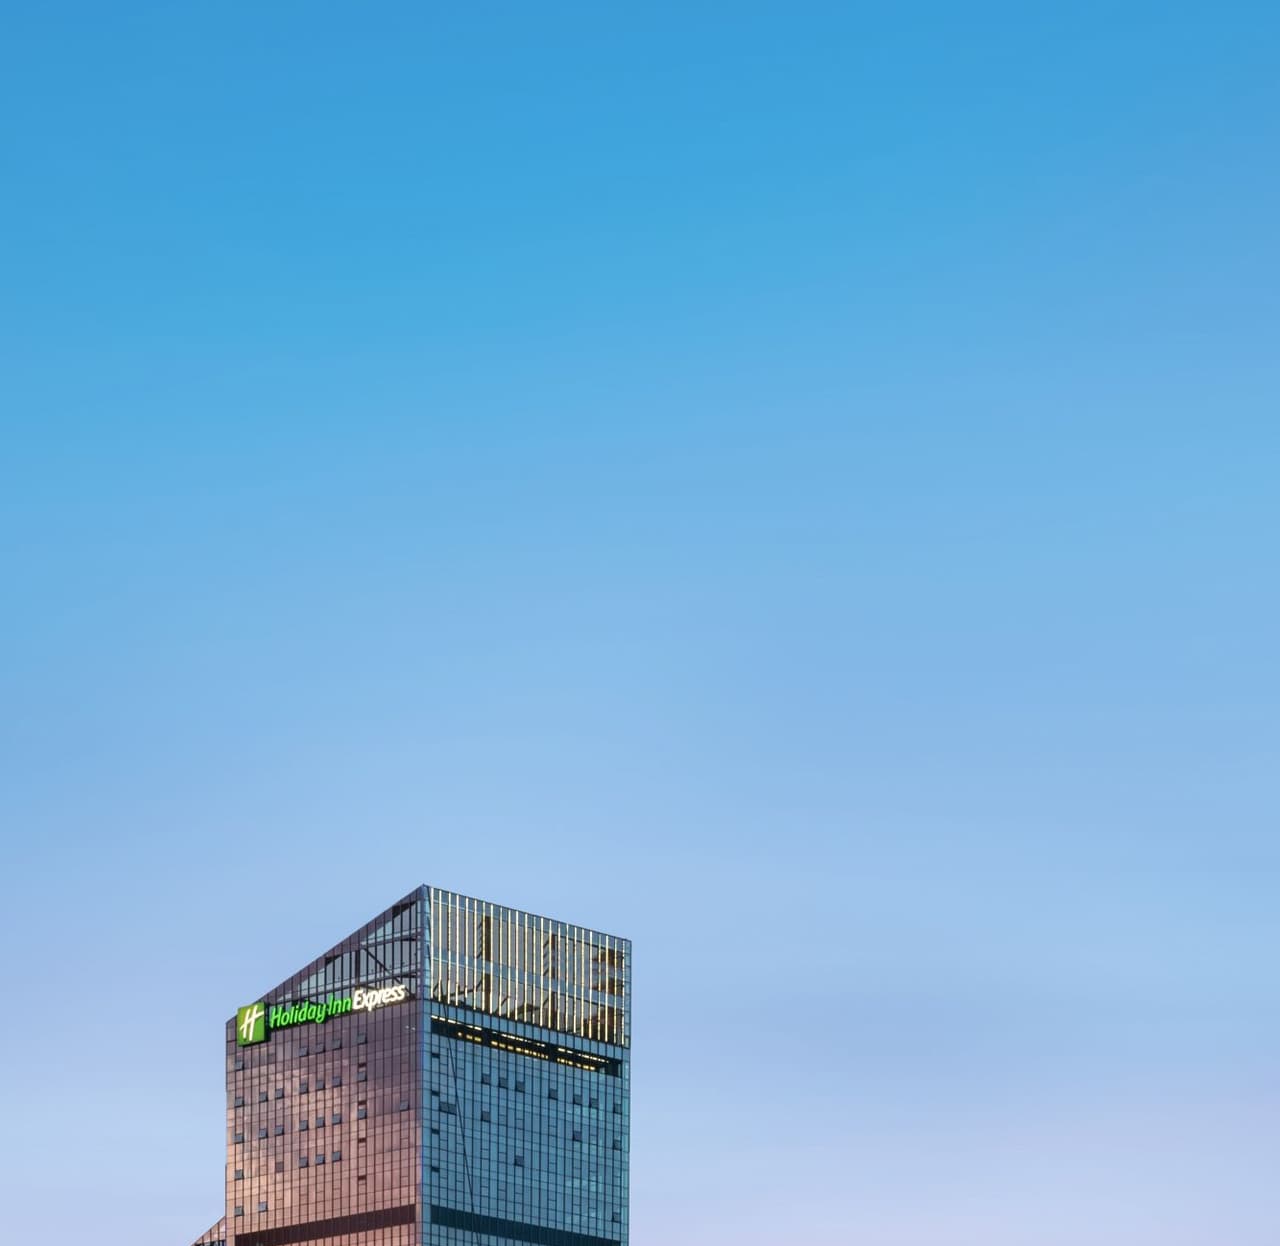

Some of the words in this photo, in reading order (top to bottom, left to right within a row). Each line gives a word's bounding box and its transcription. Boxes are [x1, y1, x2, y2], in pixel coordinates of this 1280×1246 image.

[270, 1001, 327, 1029] Holiday
[328, 994, 352, 1015] Inn
[352, 984, 406, 1012] Express
